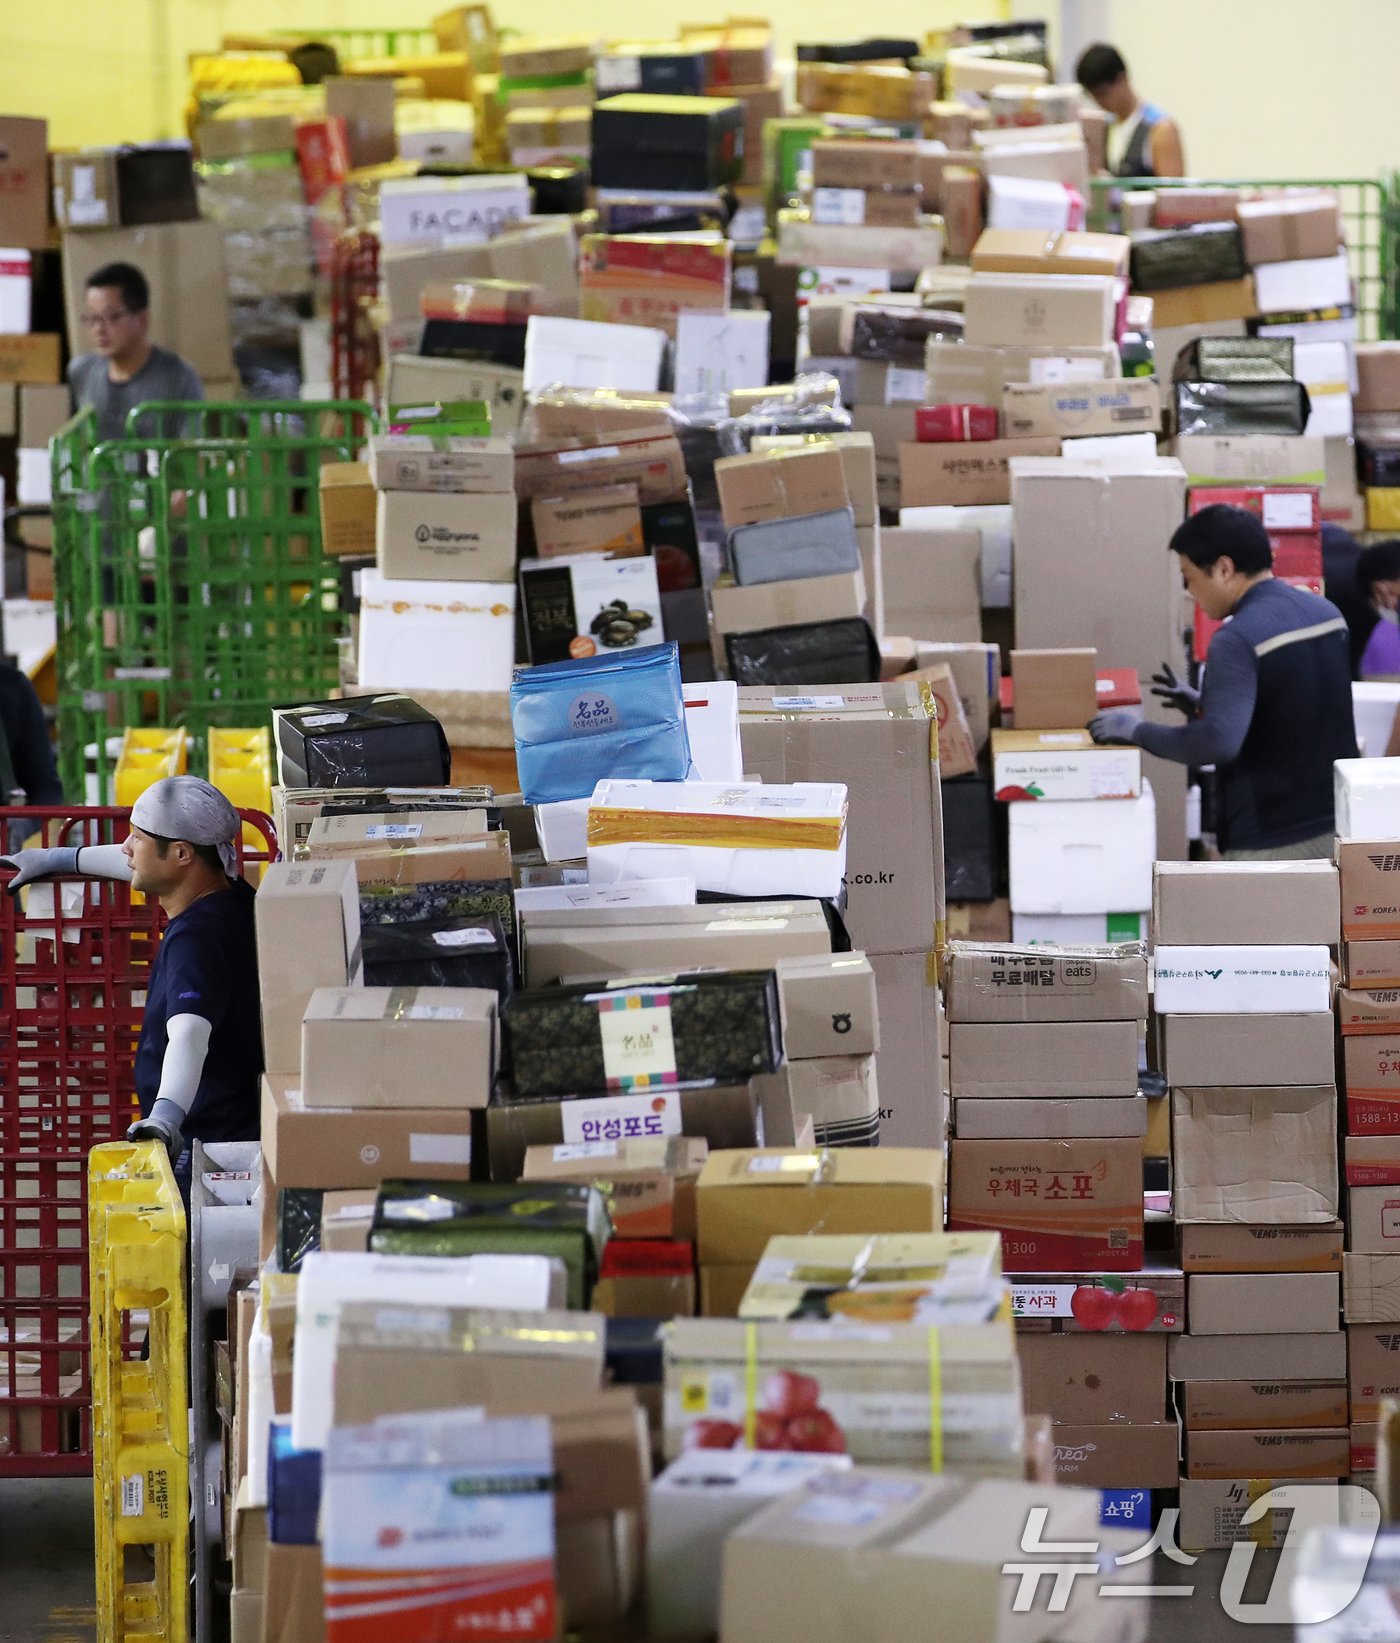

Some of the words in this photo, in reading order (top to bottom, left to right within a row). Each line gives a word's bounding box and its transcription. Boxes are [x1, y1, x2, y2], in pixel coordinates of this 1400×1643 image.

[1372, 906, 1397, 914] KOREA
[990, 969, 1055, 987] 무료배달
[1065, 966, 1092, 978] eats
[1376, 991, 1399, 1003] EMS
[1355, 1112, 1400, 1124] 1588-13
[581, 1115, 664, 1142] 안성포도
[986, 1178, 1040, 1198] 우체국
[1044, 1175, 1096, 1200] 소포
[1256, 1228, 1278, 1239] EMS
[1028, 1295, 1058, 1309] 사과
[1259, 1385, 1281, 1396] EMS
[1261, 1435, 1283, 1446] EMS
